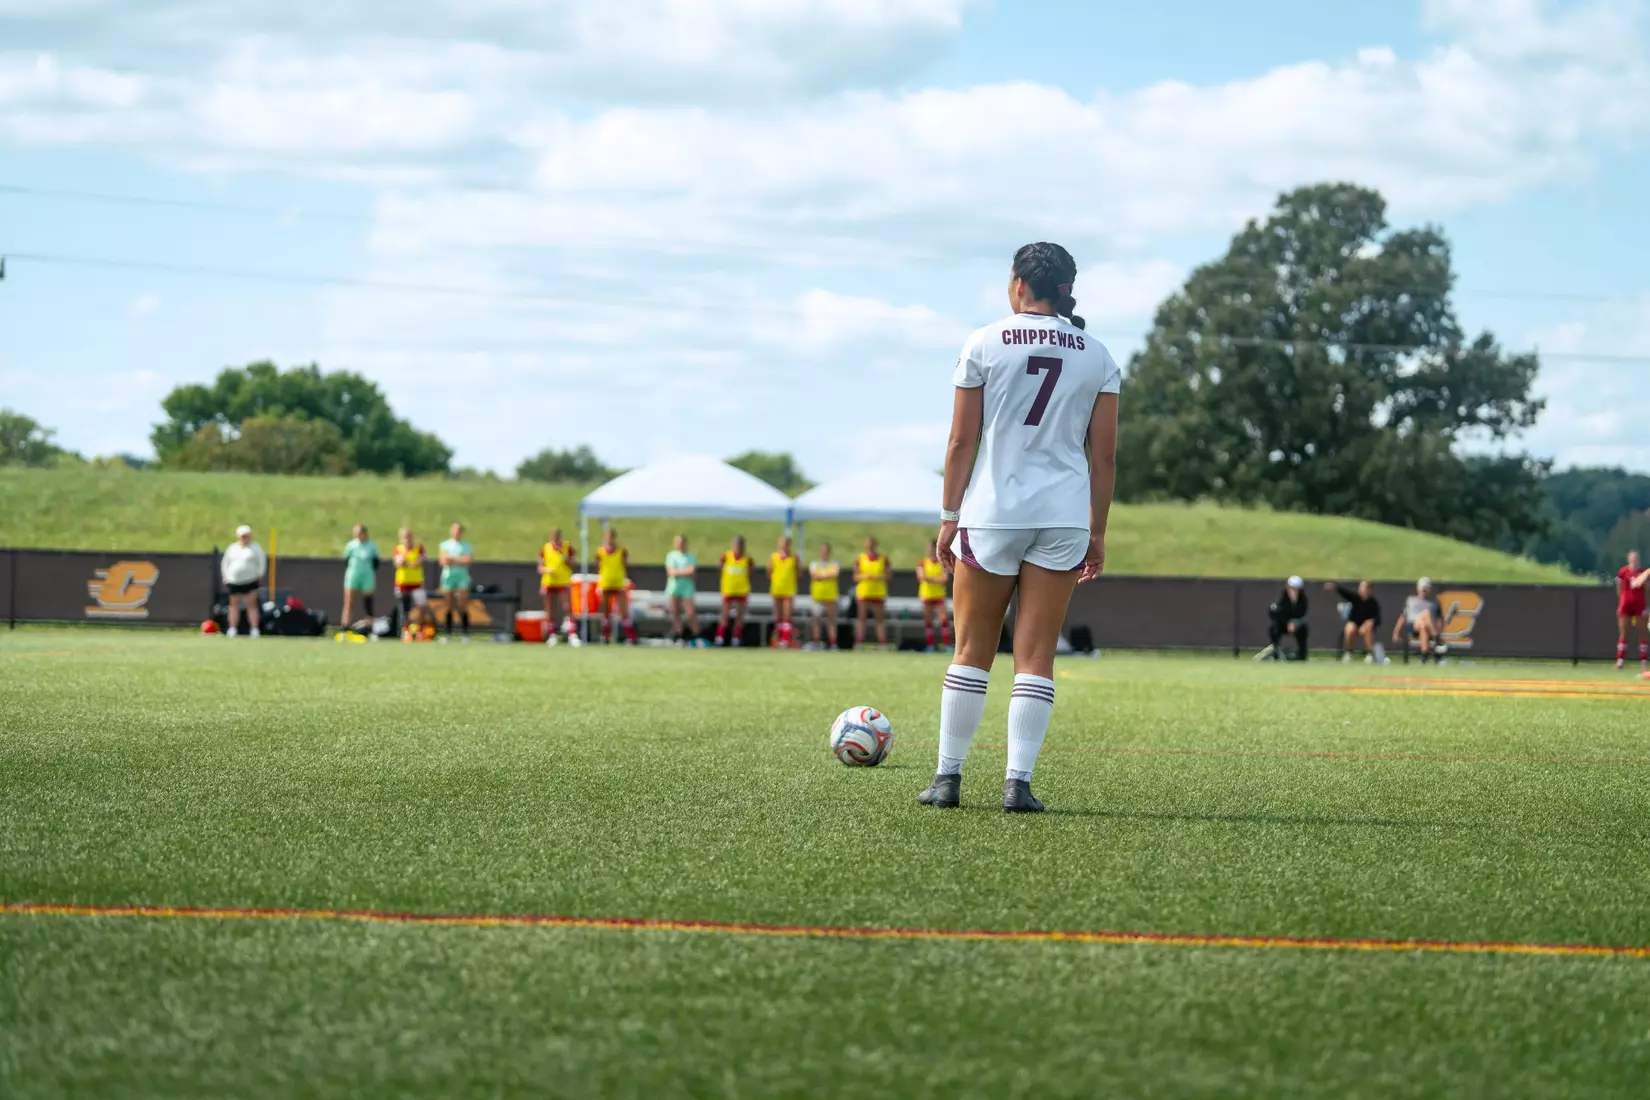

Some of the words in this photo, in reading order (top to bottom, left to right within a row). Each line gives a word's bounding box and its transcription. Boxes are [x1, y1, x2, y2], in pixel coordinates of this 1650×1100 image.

[1001, 329, 1086, 351] CHIPPEWAS
[1023, 355, 1063, 427] 7
[87, 560, 159, 614] C
